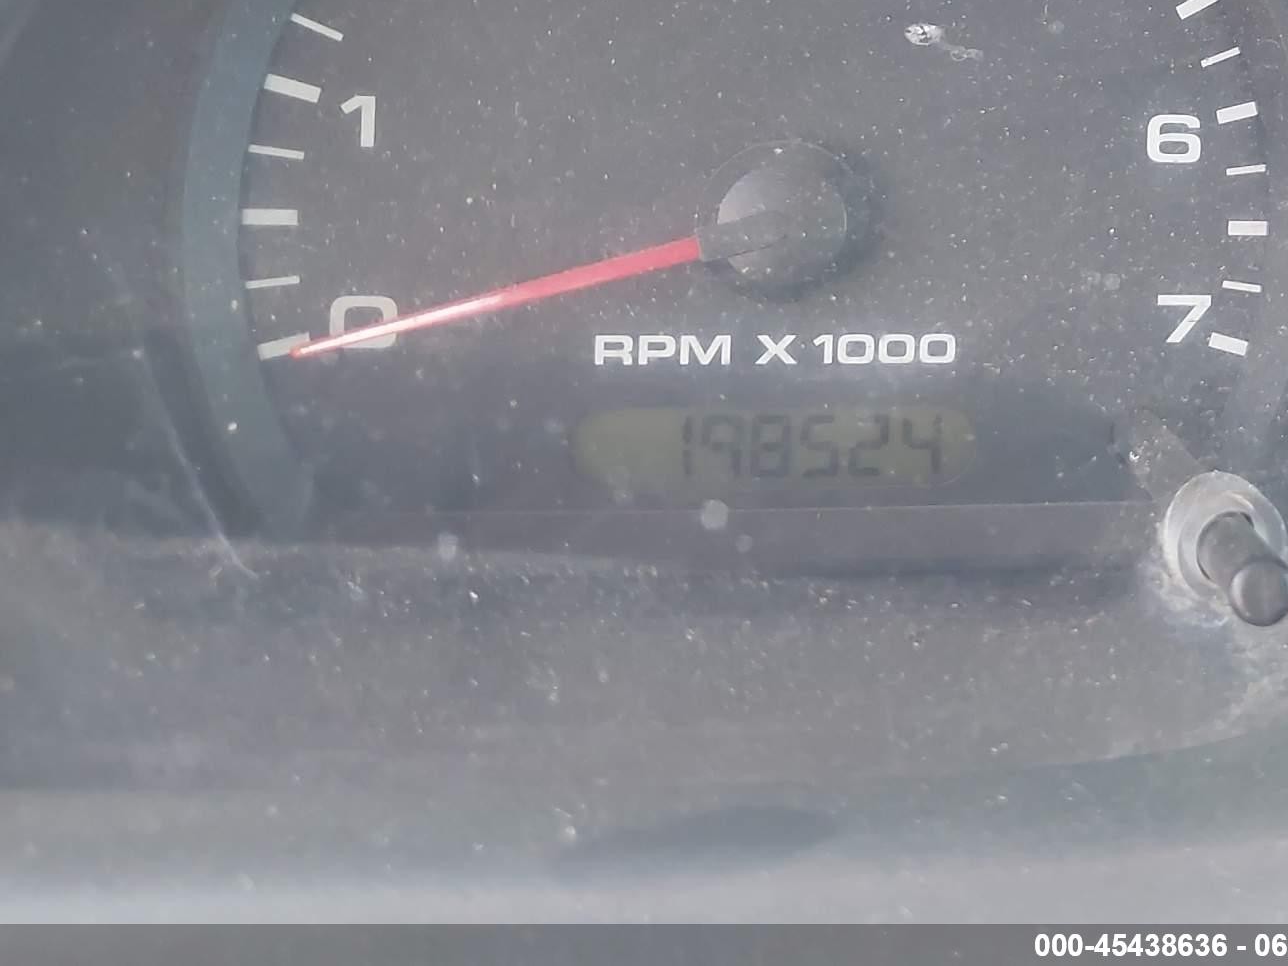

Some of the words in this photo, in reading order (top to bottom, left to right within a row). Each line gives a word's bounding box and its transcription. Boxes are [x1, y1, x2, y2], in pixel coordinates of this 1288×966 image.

[340, 95, 376, 148] 1
[1146, 114, 1201, 164] 6
[329, 295, 398, 350] 0
[1157, 294, 1212, 343] 7
[594, 334, 732, 366] RPM
[754, 334, 799, 365] X
[813, 333, 957, 365] 1000
[681, 411, 943, 479] 198524
